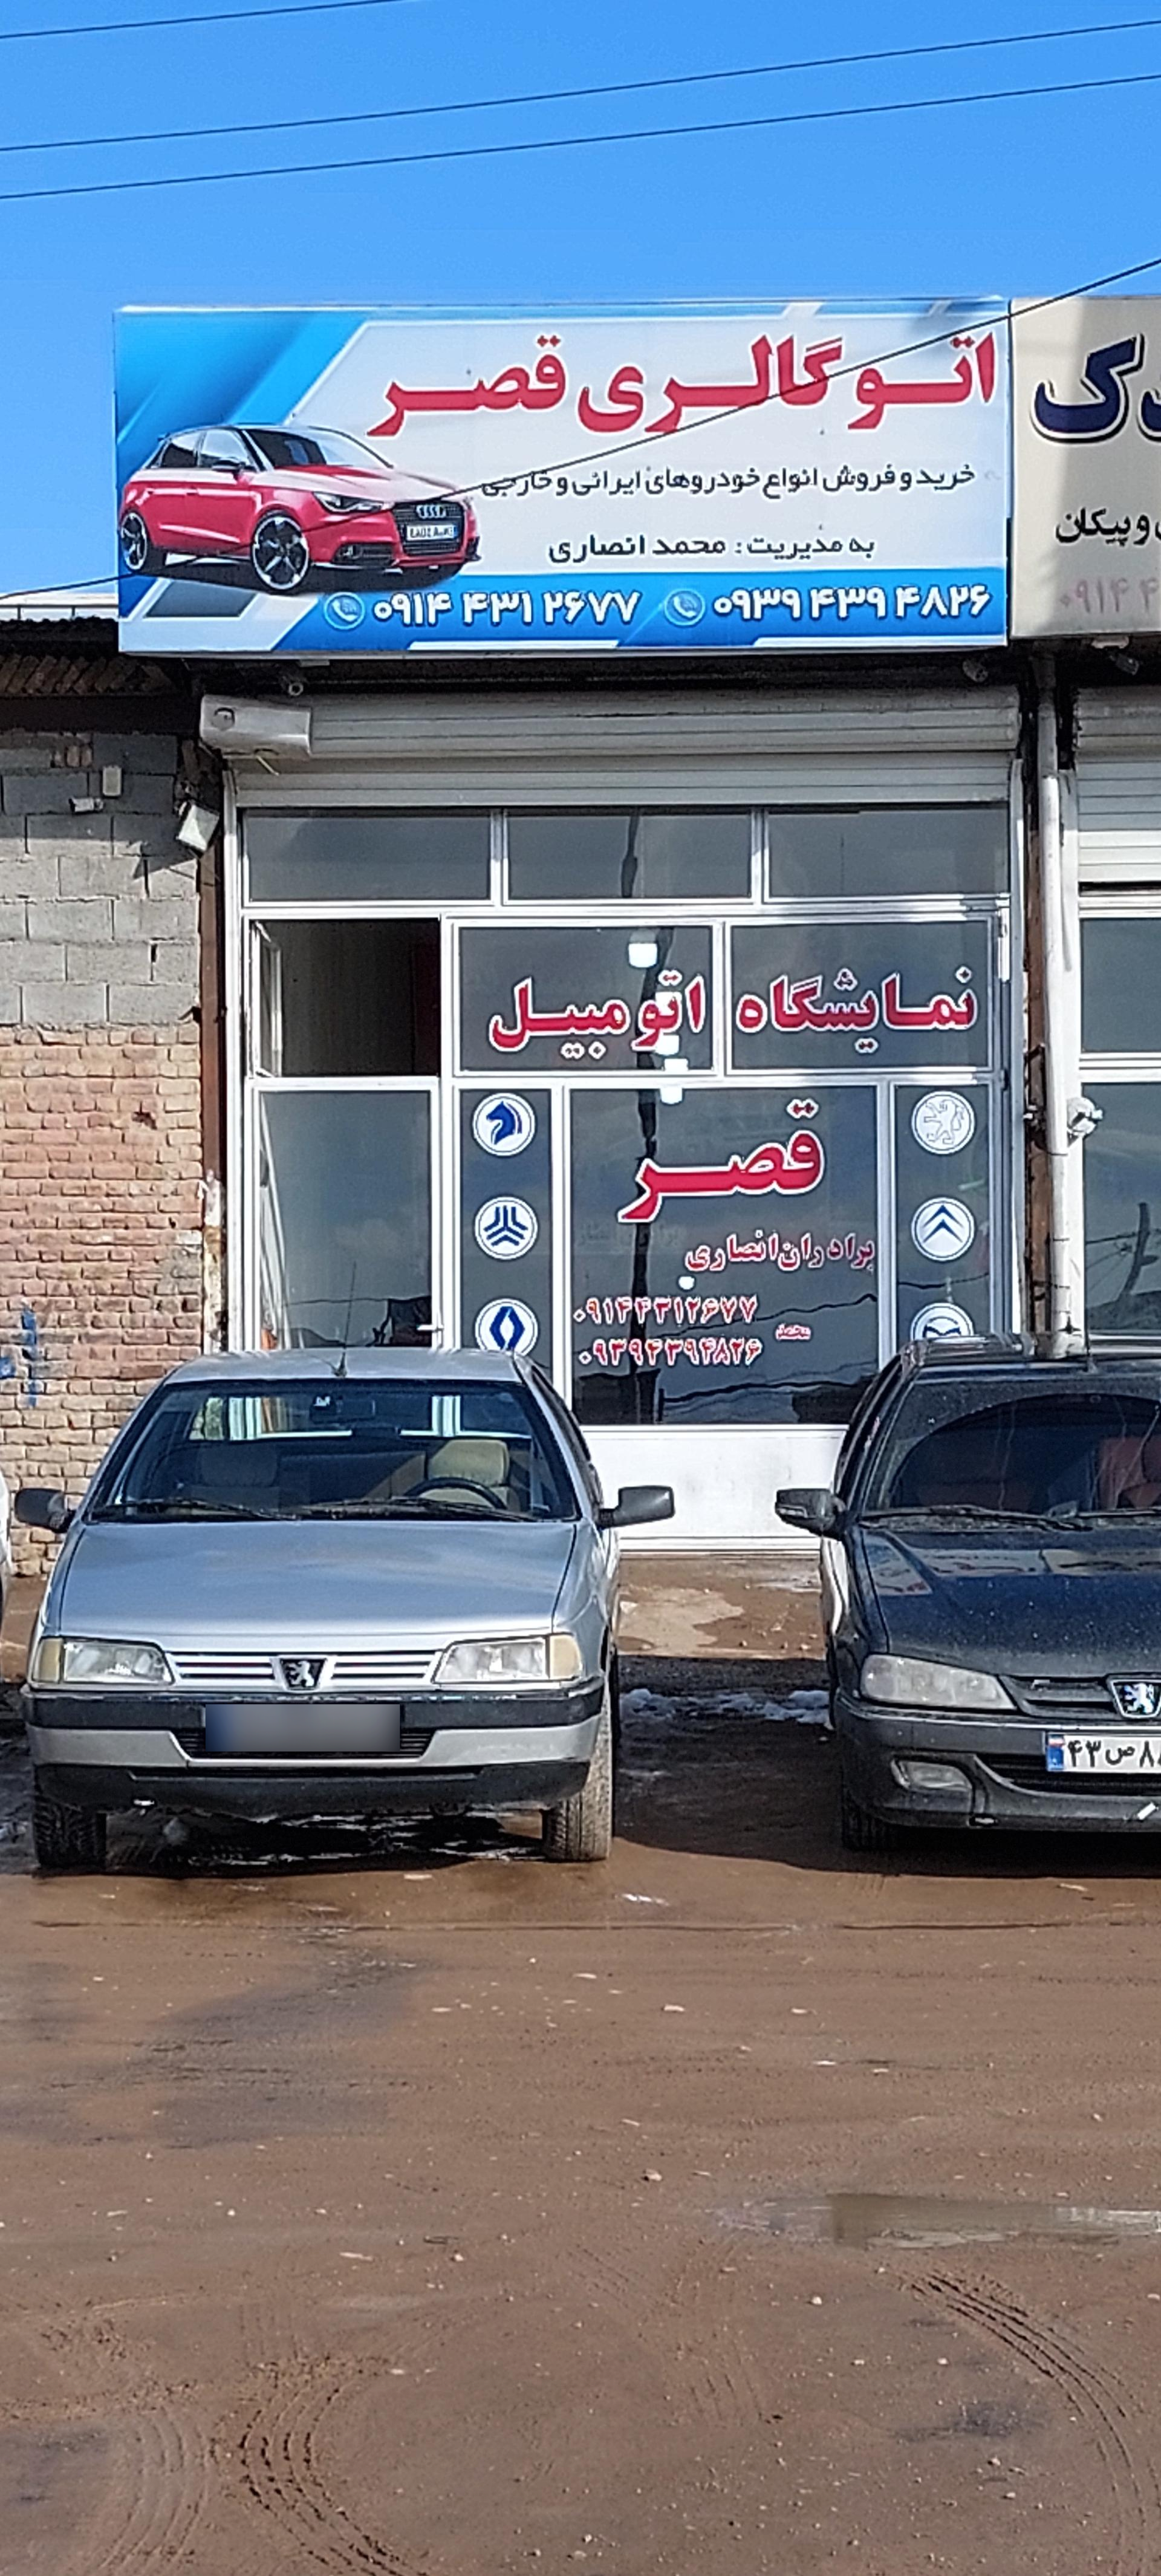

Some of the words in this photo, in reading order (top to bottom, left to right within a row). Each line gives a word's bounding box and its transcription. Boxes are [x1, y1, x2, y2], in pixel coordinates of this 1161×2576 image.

[366, 334, 566, 437] قصر
[577, 334, 842, 434] گالری
[848, 332, 996, 430] اتو
[481, 471, 552, 497] خارجی
[556, 476, 568, 496] و
[572, 470, 641, 496] ایرانی
[645, 467, 761, 496] خودروهای
[763, 467, 818, 499] انواع
[822, 464, 895, 492] فروش
[900, 472, 912, 491] و
[916, 464, 975, 491] خرید
[1055, 507, 1131, 547] پیکان
[1133, 514, 1150, 546] و
[549, 535, 645, 563] انصاری
[652, 539, 726, 555] محمد
[747, 538, 842, 560] مدیریت
[849, 538, 875, 558] به
[374, 593, 452, 624] ۰۹۱۴
[463, 592, 532, 623] ۴۳۱
[543, 590, 640, 623] ۲۶۷۷
[714, 589, 800, 620] ۰۹۳۹
[810, 587, 885, 619] ۴۳۹
[896, 586, 990, 617] ۴۸۲۶
[489, 970, 706, 1060] اتومبیل
[737, 967, 978, 1053] نمایشگاه
[617, 1099, 825, 1223] قصر
[685, 1229, 779, 1272] انصاری
[776, 1232, 876, 1272] برادران
[573, 1295, 758, 1325] ۰۹۱۴۴۳۱۲۶۷۷
[578, 1337, 763, 1367] ۰۹۳۹۴۳۹۴۸۲۶
